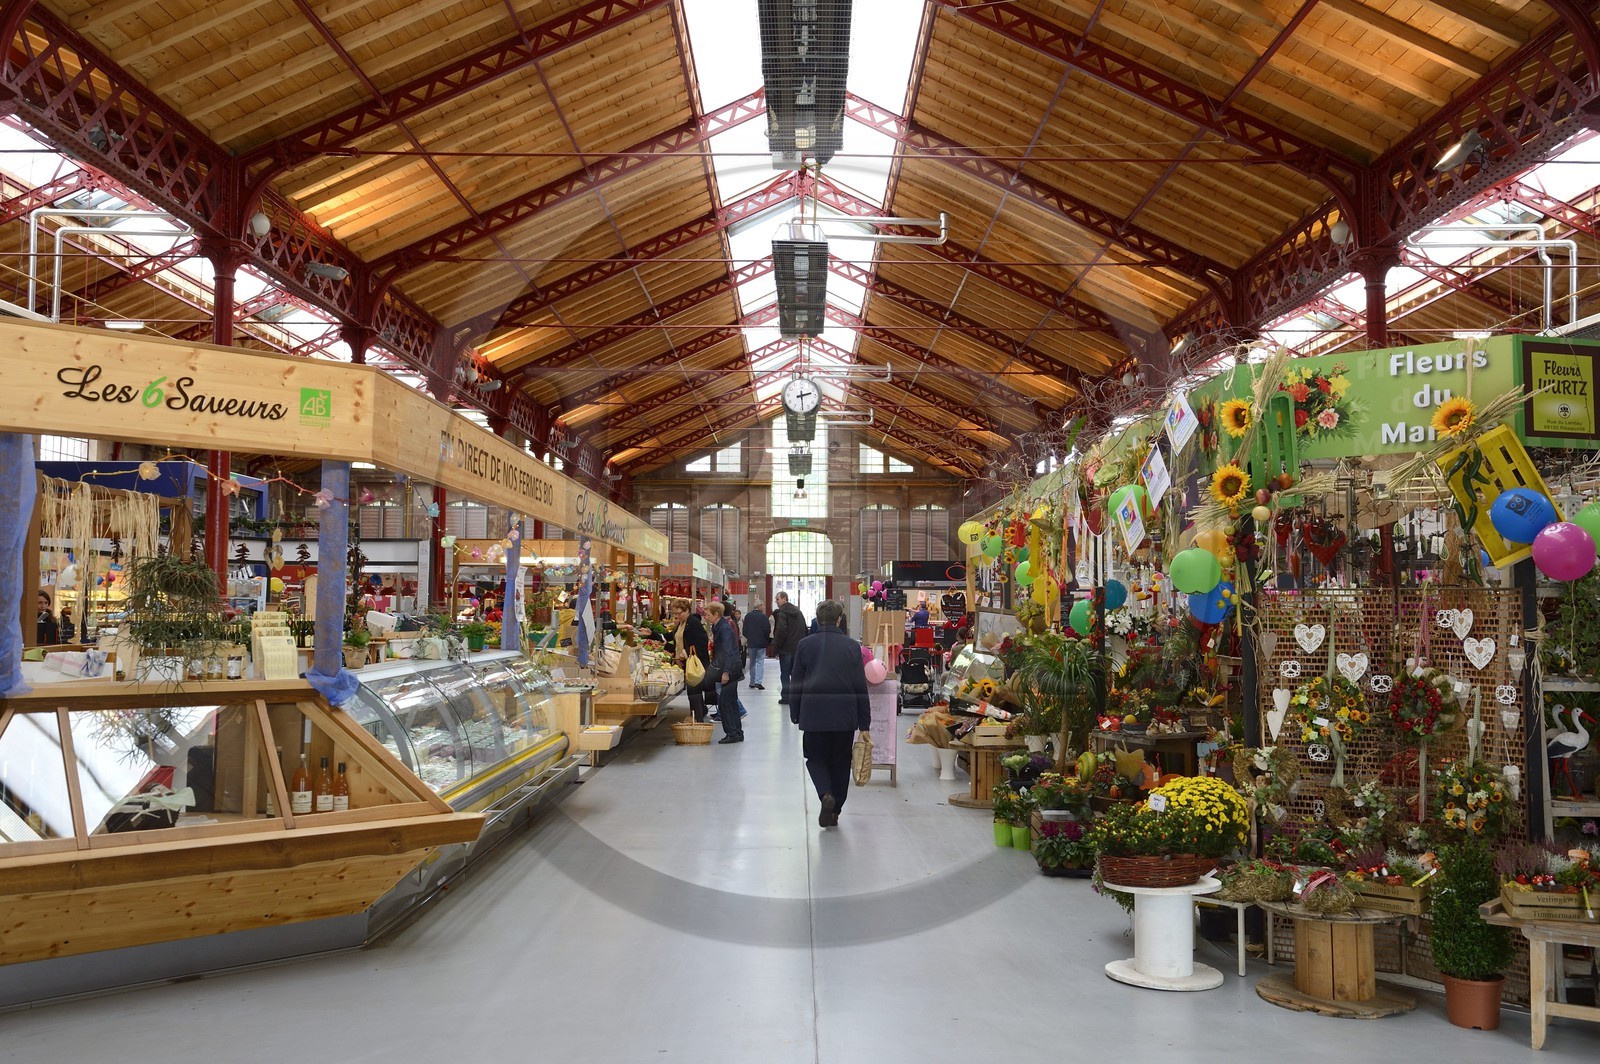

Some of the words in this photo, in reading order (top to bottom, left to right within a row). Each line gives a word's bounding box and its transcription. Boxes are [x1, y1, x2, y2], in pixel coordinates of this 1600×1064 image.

[1390, 350, 1488, 376] Fleurs
[1543, 359, 1581, 377] Fleurs
[56, 364, 139, 403] Les
[142, 376, 167, 408] 6
[165, 376, 288, 421] Saveurs
[1413, 383, 1451, 408] du
[441, 430, 454, 464] EN
[457, 438, 489, 479] DIRECT
[490, 455, 501, 484] DE
[502, 461, 518, 491] NOS
[519, 469, 542, 502] FERMES
[543, 481, 553, 506] BIO
